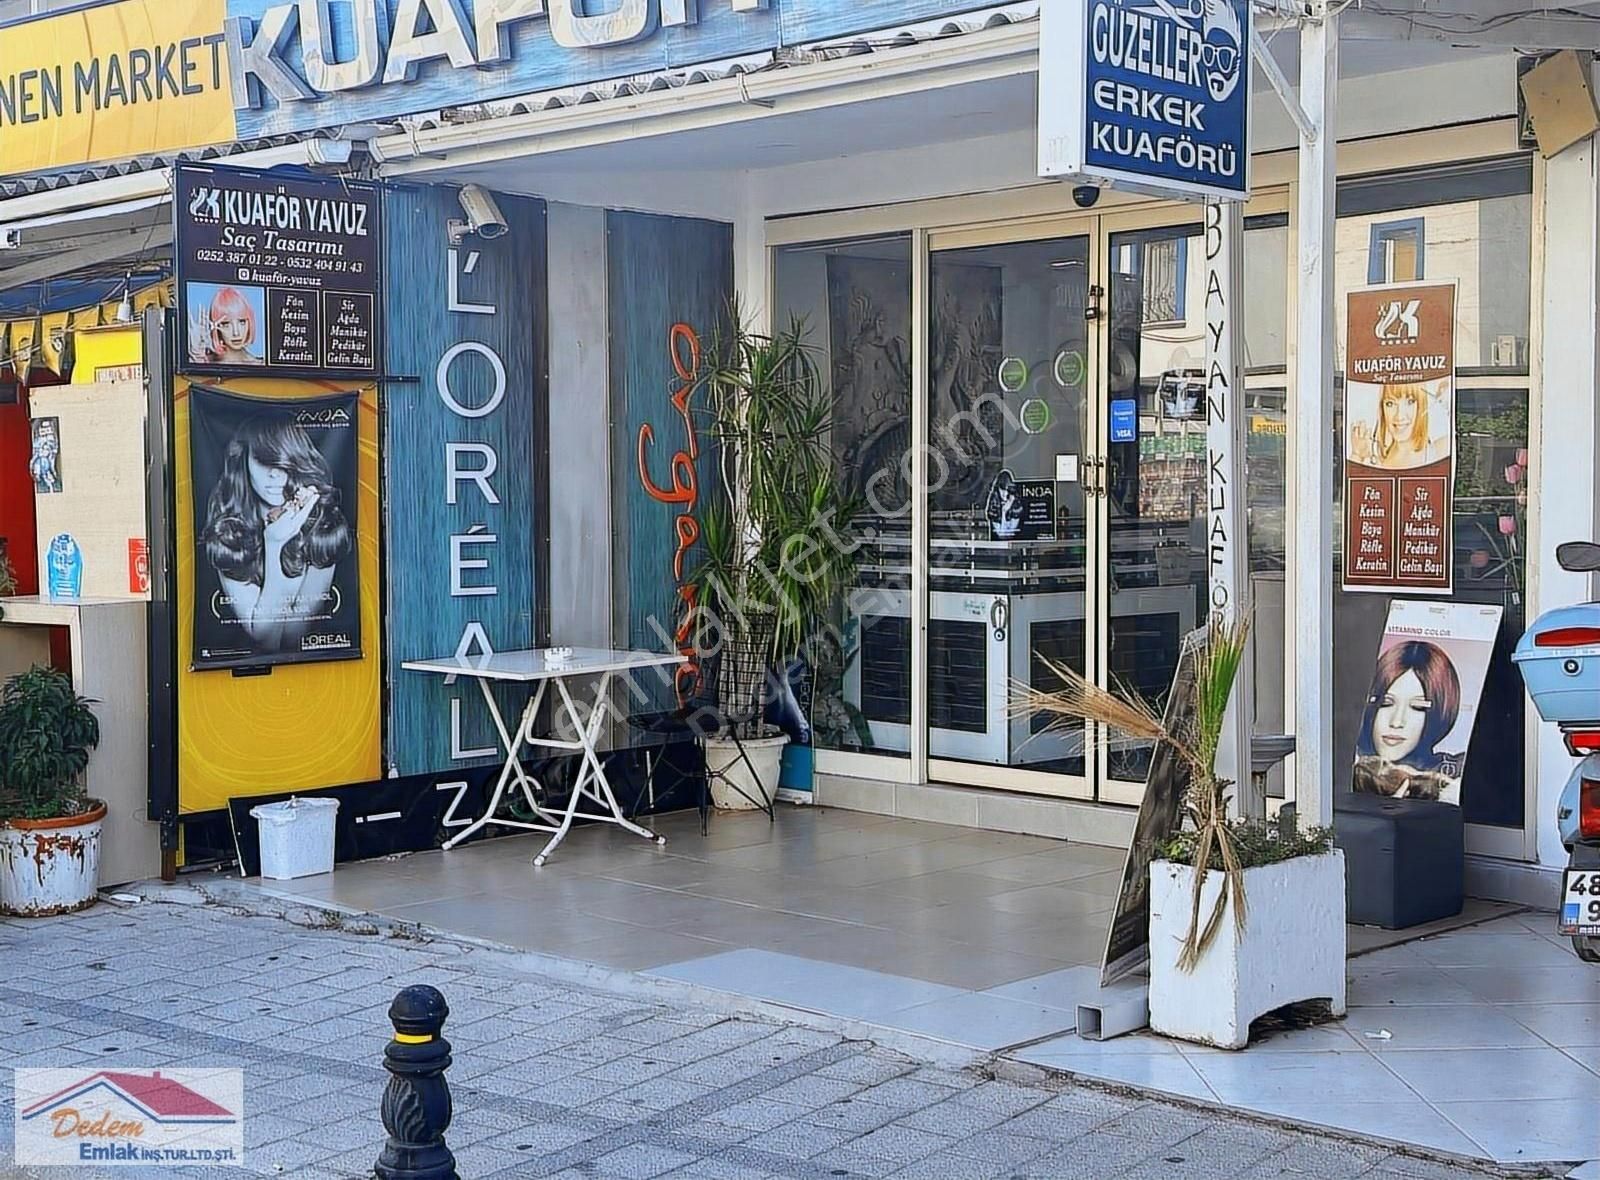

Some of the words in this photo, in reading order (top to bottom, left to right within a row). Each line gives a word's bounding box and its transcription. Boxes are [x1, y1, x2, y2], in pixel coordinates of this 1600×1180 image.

[1092, 0, 1202, 88] GÜZELLER
[74, 33, 225, 114] MARKET
[1094, 79, 1206, 131] ERKEK
[1092, 121, 1236, 177] KUAFÖRÜ
[224, 186, 302, 231] KUAFÖR
[305, 198, 368, 236] YAVUZ
[221, 226, 257, 252] Saç
[263, 230, 344, 256] Tasarımı
[197, 249, 225, 263] 0252
[226, 251, 247, 264] 387
[249, 253, 261, 265] 01
[264, 255, 278, 267] 22
[287, 256, 312, 269] 0532
[314, 259, 333, 271] 404
[335, 260, 347, 272] 91
[350, 262, 363, 273] 43
[280, 308, 309, 321] Kesim
[278, 349, 313, 361] Keratin
[327, 352, 351, 364] Gelin
[1354, 355, 1402, 374] KUAFÖR
[1404, 355, 1447, 370] YAVUZ
[1359, 503, 1386, 517] Kesim
[1403, 522, 1441, 537] Manikür
[1355, 556, 1388, 571] Keratin
[1400, 558, 1423, 572] Gelin
